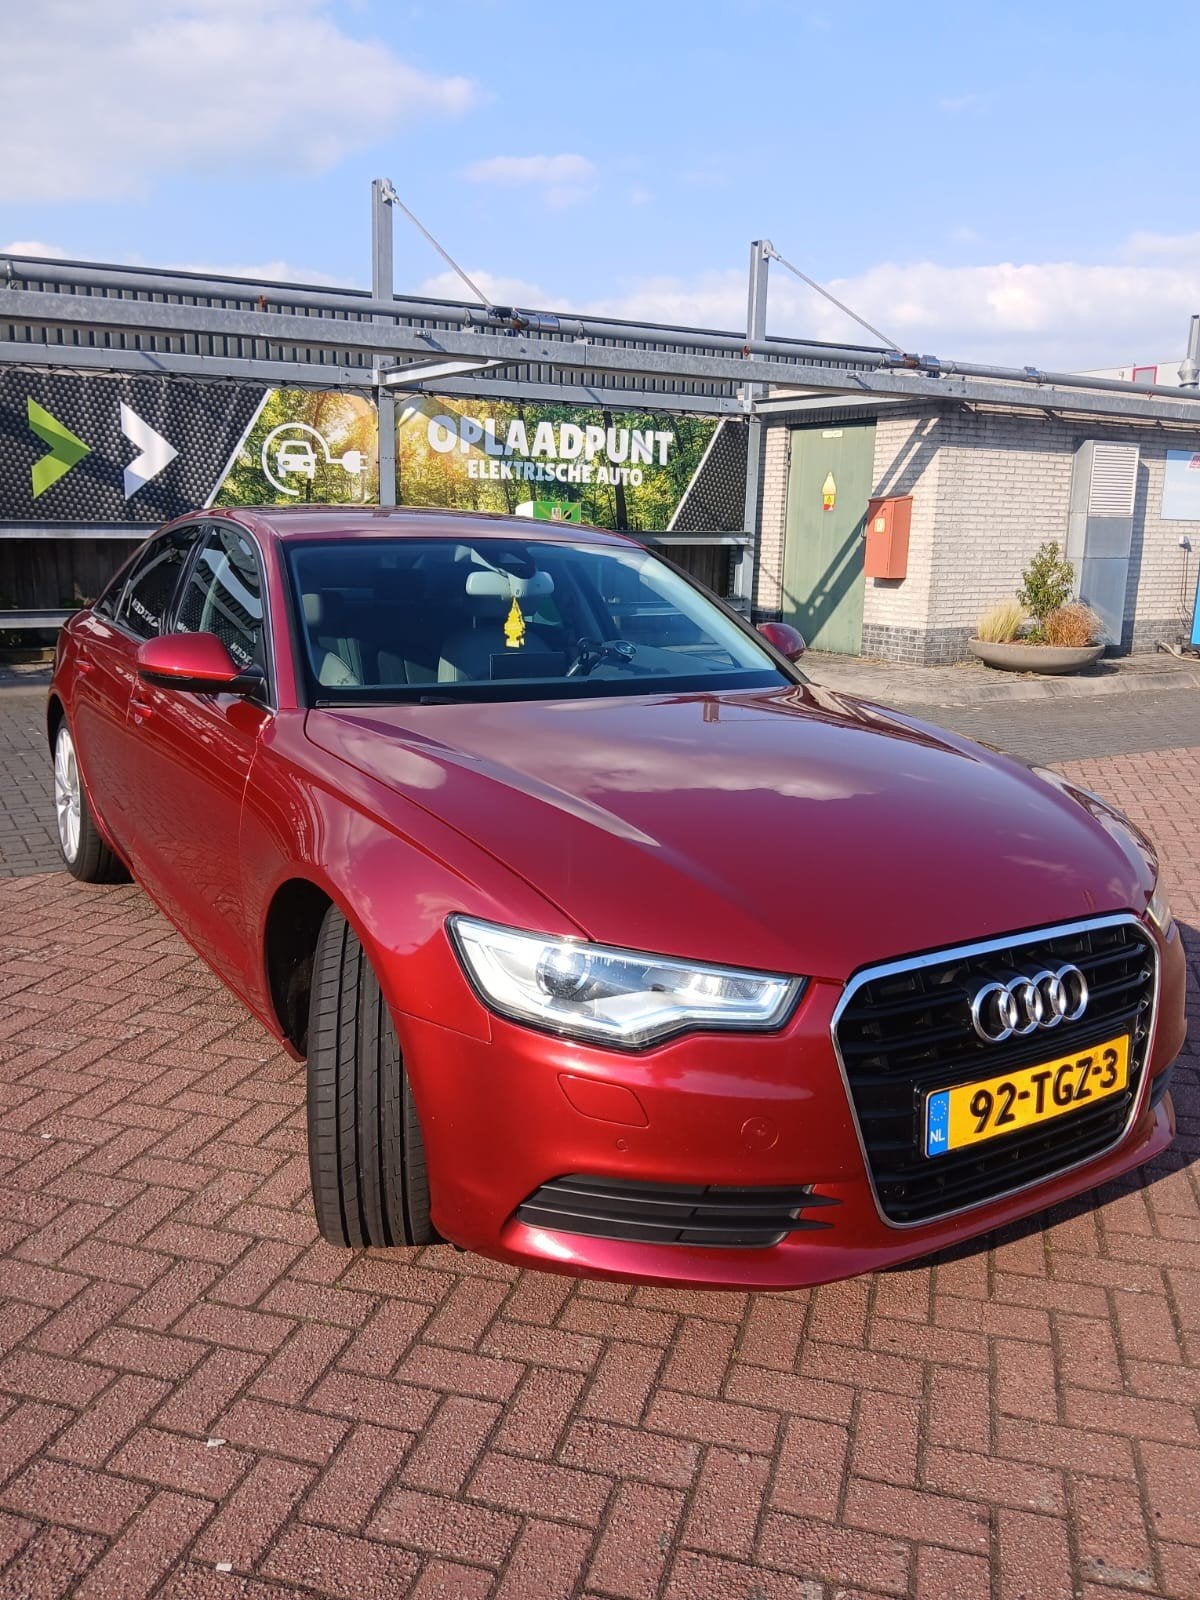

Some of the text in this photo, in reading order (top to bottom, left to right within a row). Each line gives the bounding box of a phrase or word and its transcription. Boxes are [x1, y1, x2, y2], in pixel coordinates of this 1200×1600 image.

[427, 414, 673, 466] OPLAADPUNT
[468, 459, 643, 487] ELEKTRISCHE AUTO
[930, 1048, 1118, 1144] NL 92-TGZ-3
